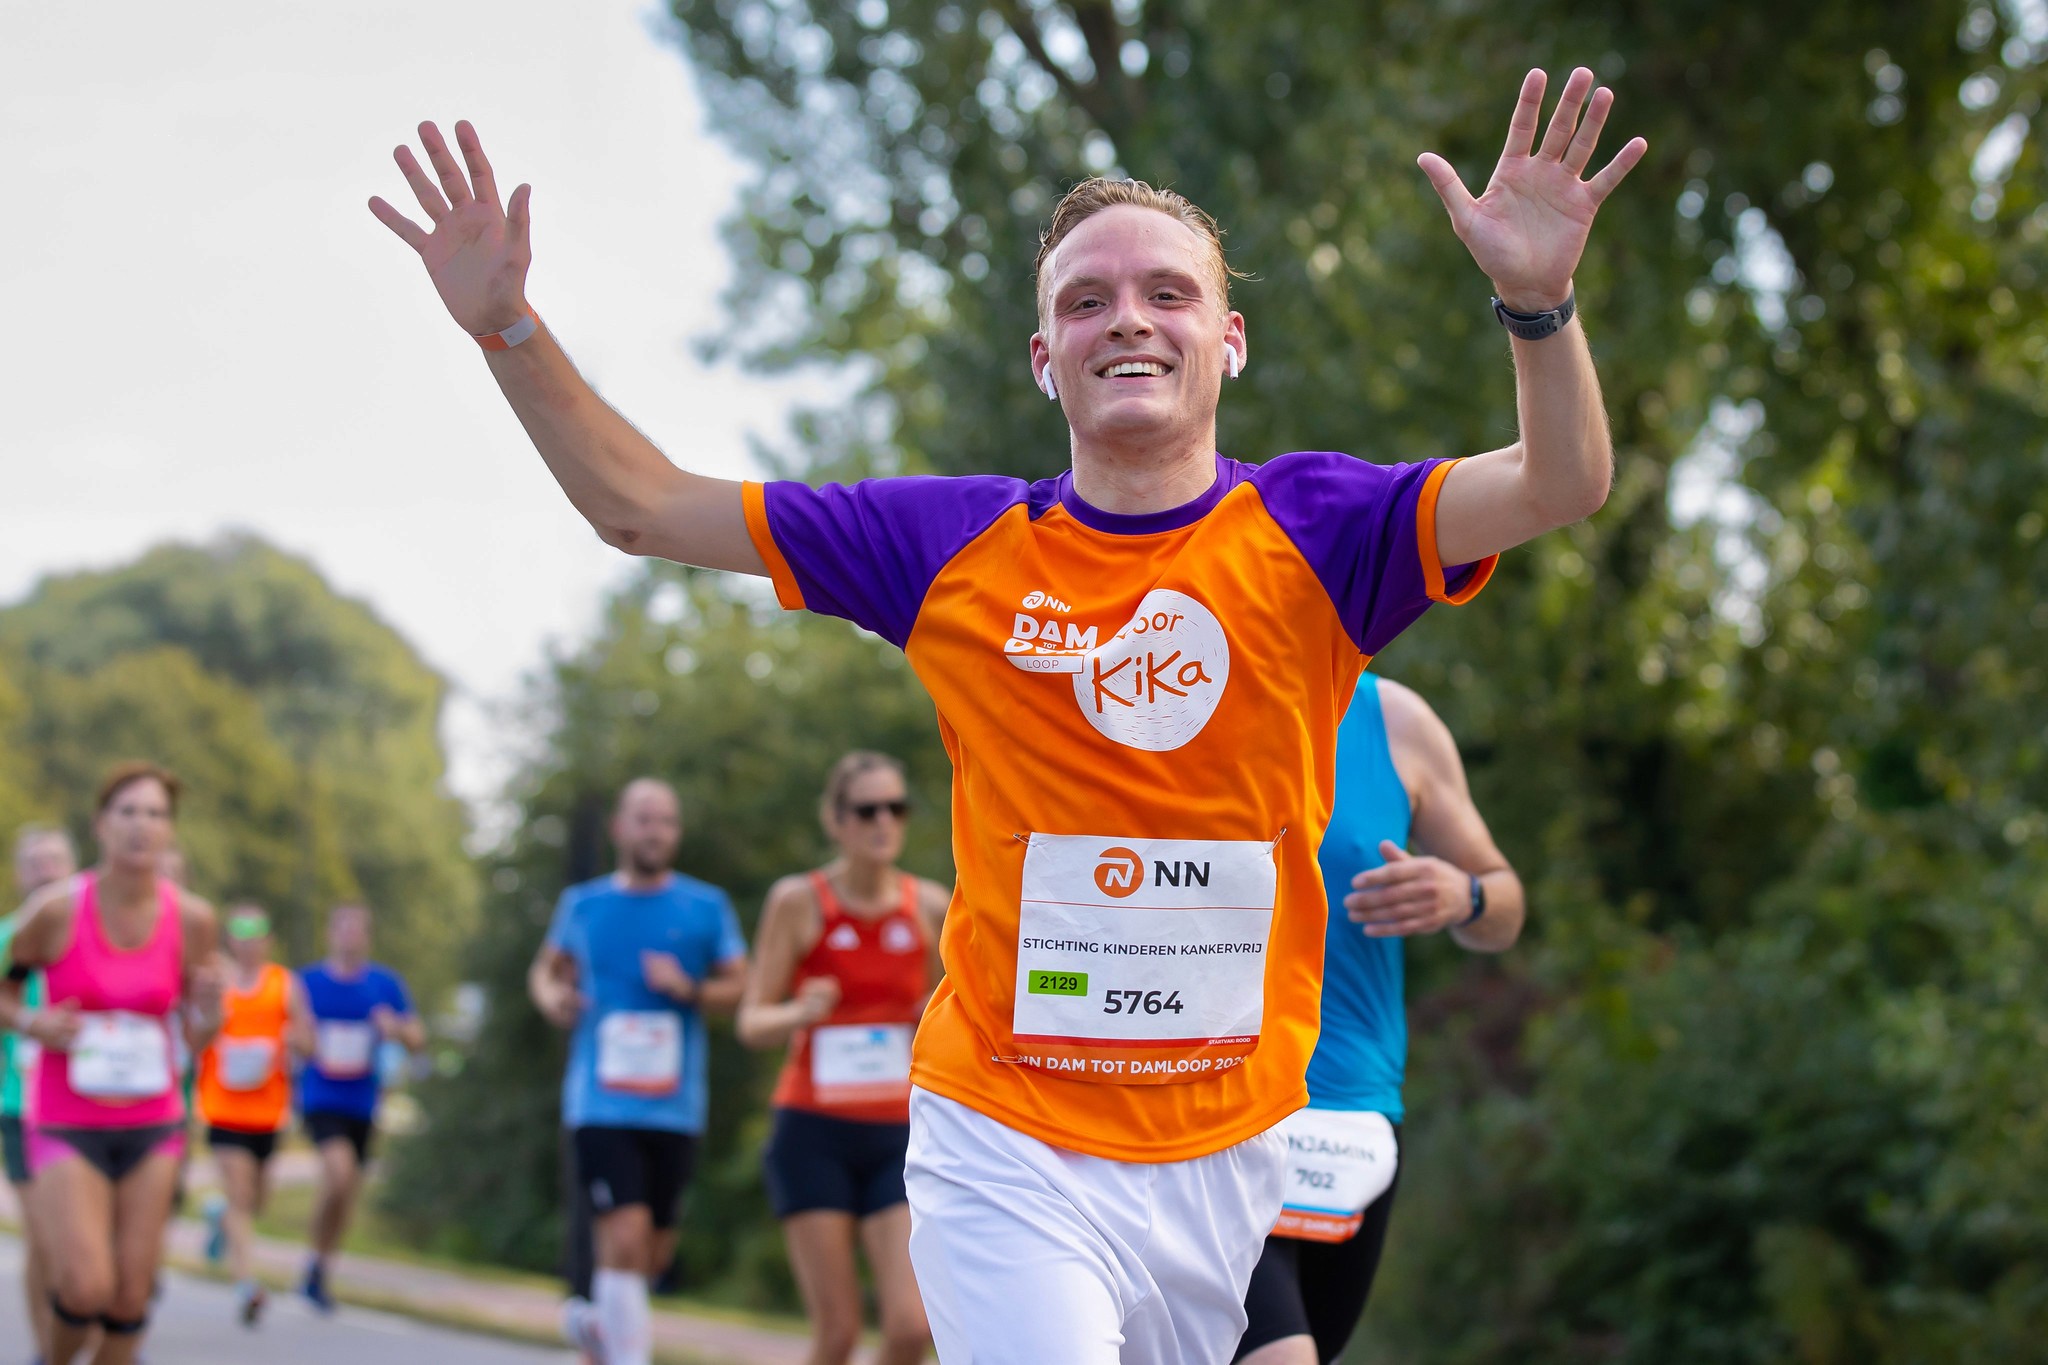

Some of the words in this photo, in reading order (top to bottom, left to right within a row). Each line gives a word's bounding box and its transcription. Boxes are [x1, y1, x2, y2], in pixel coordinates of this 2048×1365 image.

[1044, 595, 1072, 613] NN
[1012, 612, 1099, 649] DAM
[1116, 611, 1185, 640] oor
[1043, 641, 1057, 650] TOT
[1026, 659, 1060, 669] LOOP
[1091, 649, 1213, 714] KiKa
[1153, 860, 1211, 888] NN
[1023, 937, 1100, 953] STICHTING
[1103, 943, 1177, 956] KINDEREN
[1180, 943, 1263, 956] KANKERVRIJ
[1039, 975, 1079, 991] 2129
[1102, 989, 1185, 1015] 5764
[1046, 1056, 1087, 1072] DAM
[1090, 1059, 1126, 1074] TOT
[1130, 1058, 1212, 1074] DAMLOOP
[1287, 1133, 1377, 1162] NJAMIN
[1295, 1167, 1337, 1190] 702
